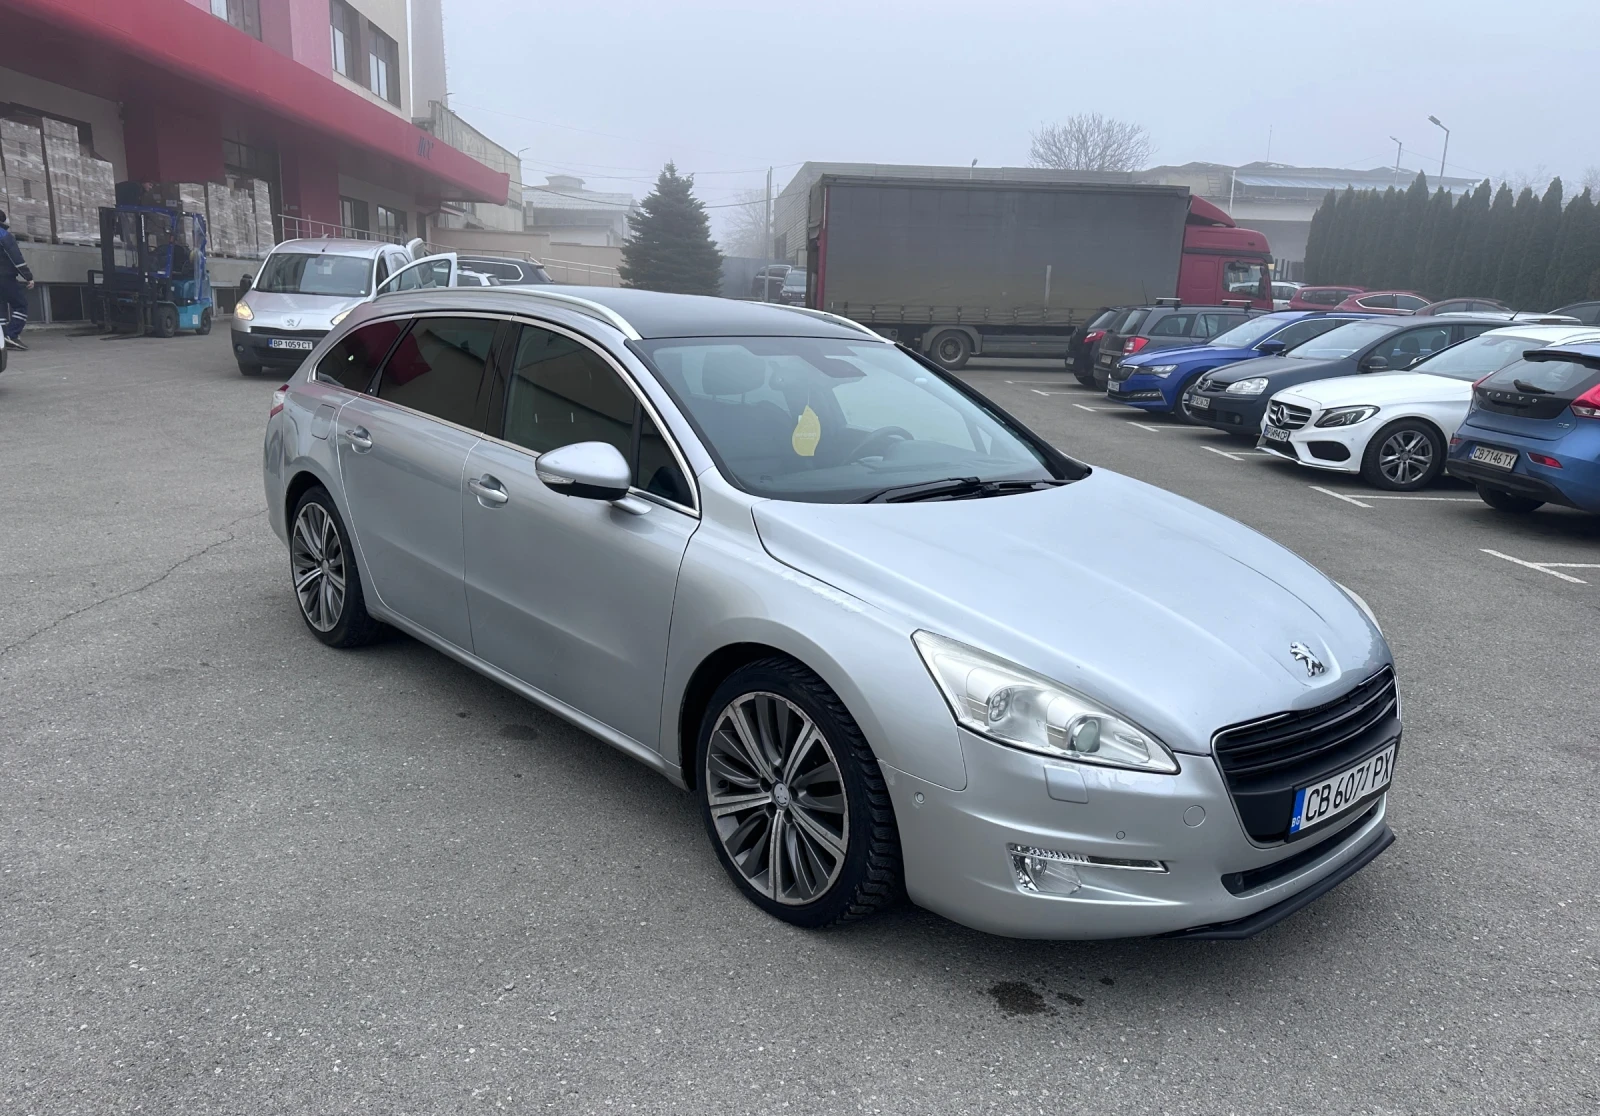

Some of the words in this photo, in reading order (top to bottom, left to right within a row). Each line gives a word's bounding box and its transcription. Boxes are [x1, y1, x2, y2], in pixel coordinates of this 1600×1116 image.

[1486, 391, 1538, 403] VOLVO
[1473, 447, 1485, 460] CB
[1483, 450, 1503, 464] 7146
[1502, 454, 1515, 467] TX
[1305, 783, 1332, 822] CB
[1333, 761, 1372, 809] 6071
[1372, 749, 1393, 788] PX
[1291, 815, 1301, 828] BG
